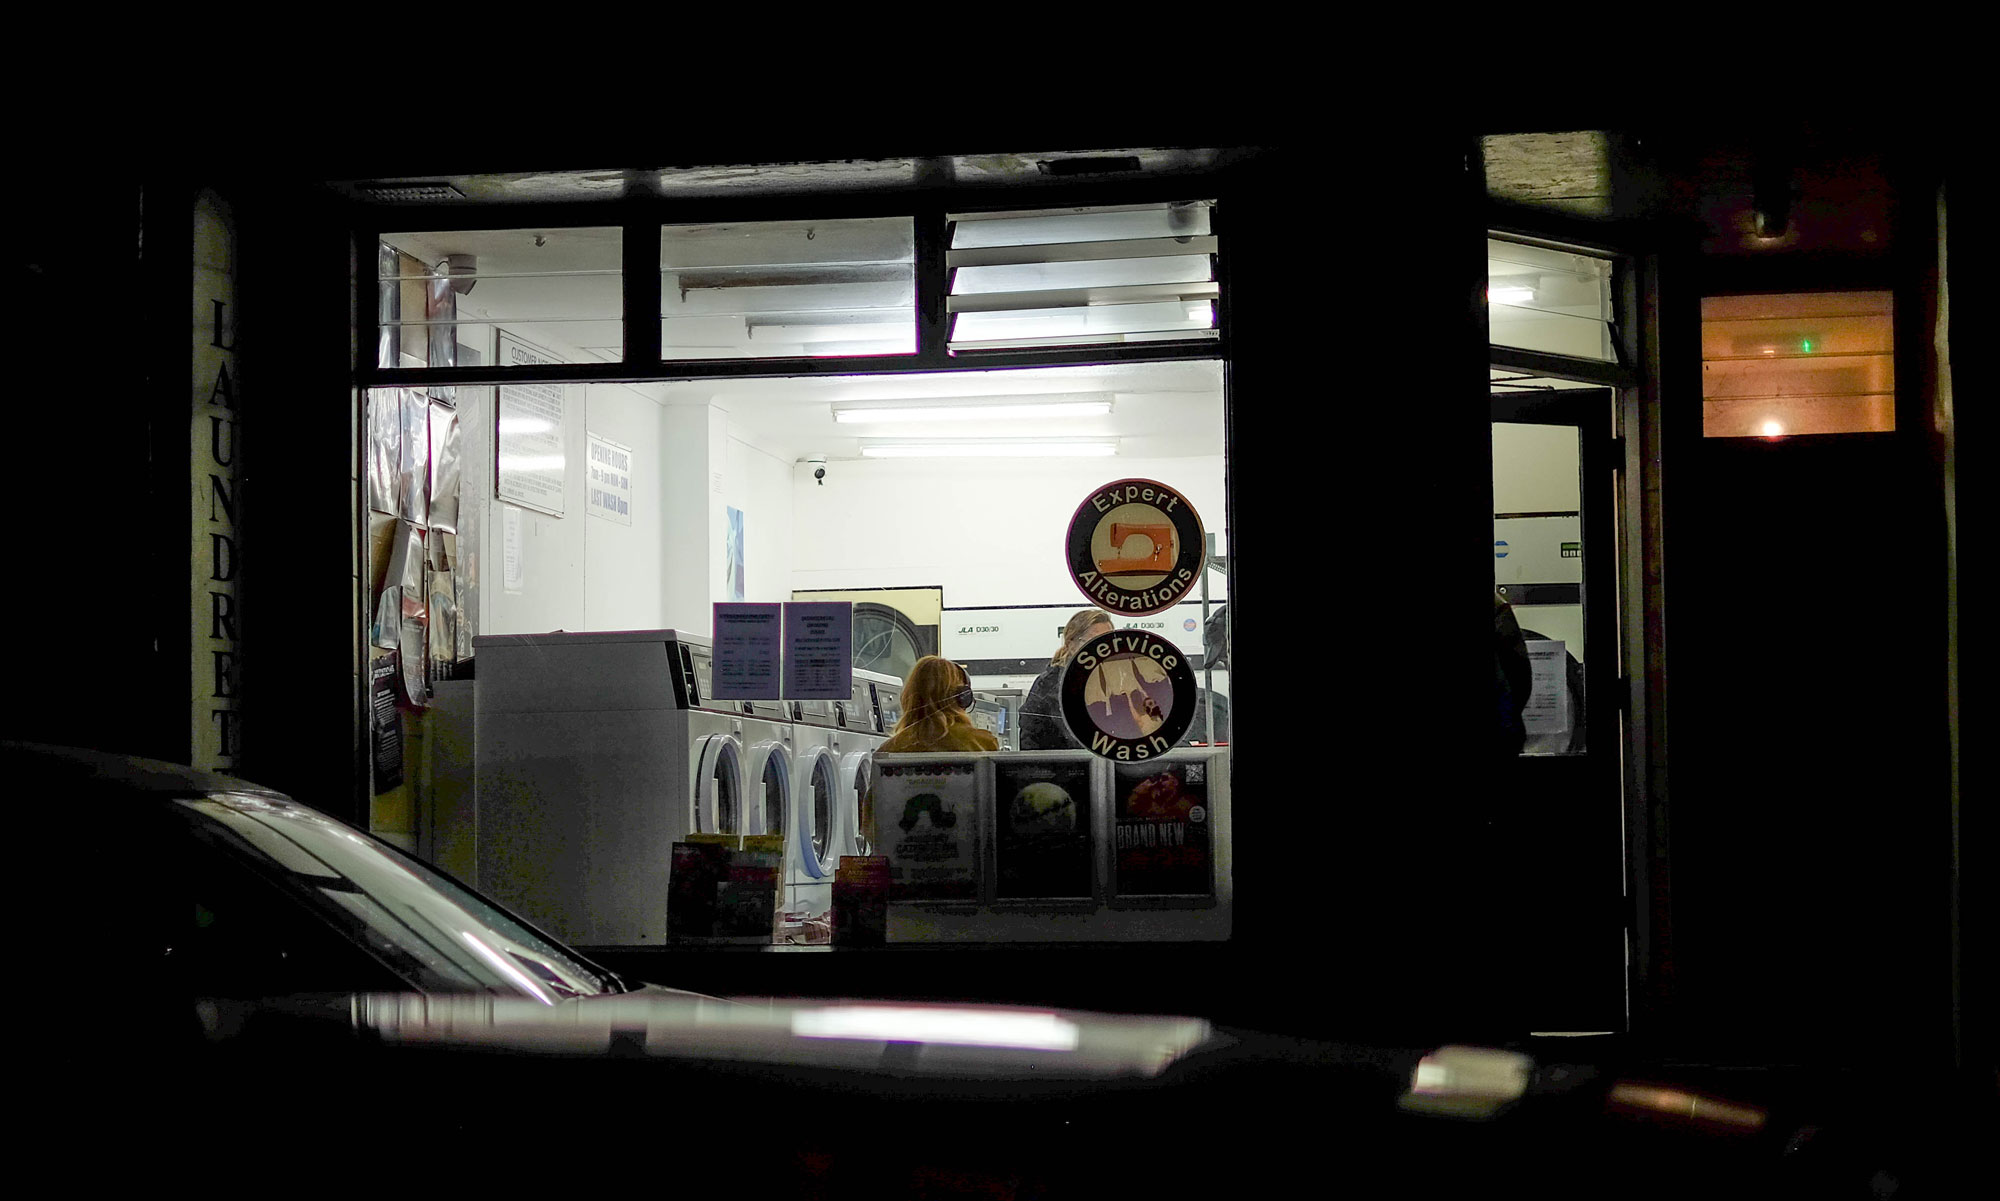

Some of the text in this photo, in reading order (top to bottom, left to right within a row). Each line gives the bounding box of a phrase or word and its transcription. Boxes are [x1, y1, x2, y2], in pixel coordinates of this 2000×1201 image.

[591, 442, 628, 473] OPENING HOURS
[591, 487, 602, 507] LAST
[603, 492, 617, 512] WASH
[1091, 485, 1179, 514] Expert
[208, 298, 240, 774] LAUNDRET
[1079, 567, 1193, 611] Alterations
[958, 626, 974, 634] JLA
[1077, 634, 1178, 671] Service
[1091, 731, 1169, 761] Wash
[1117, 822, 1184, 849] BRAND NEW
